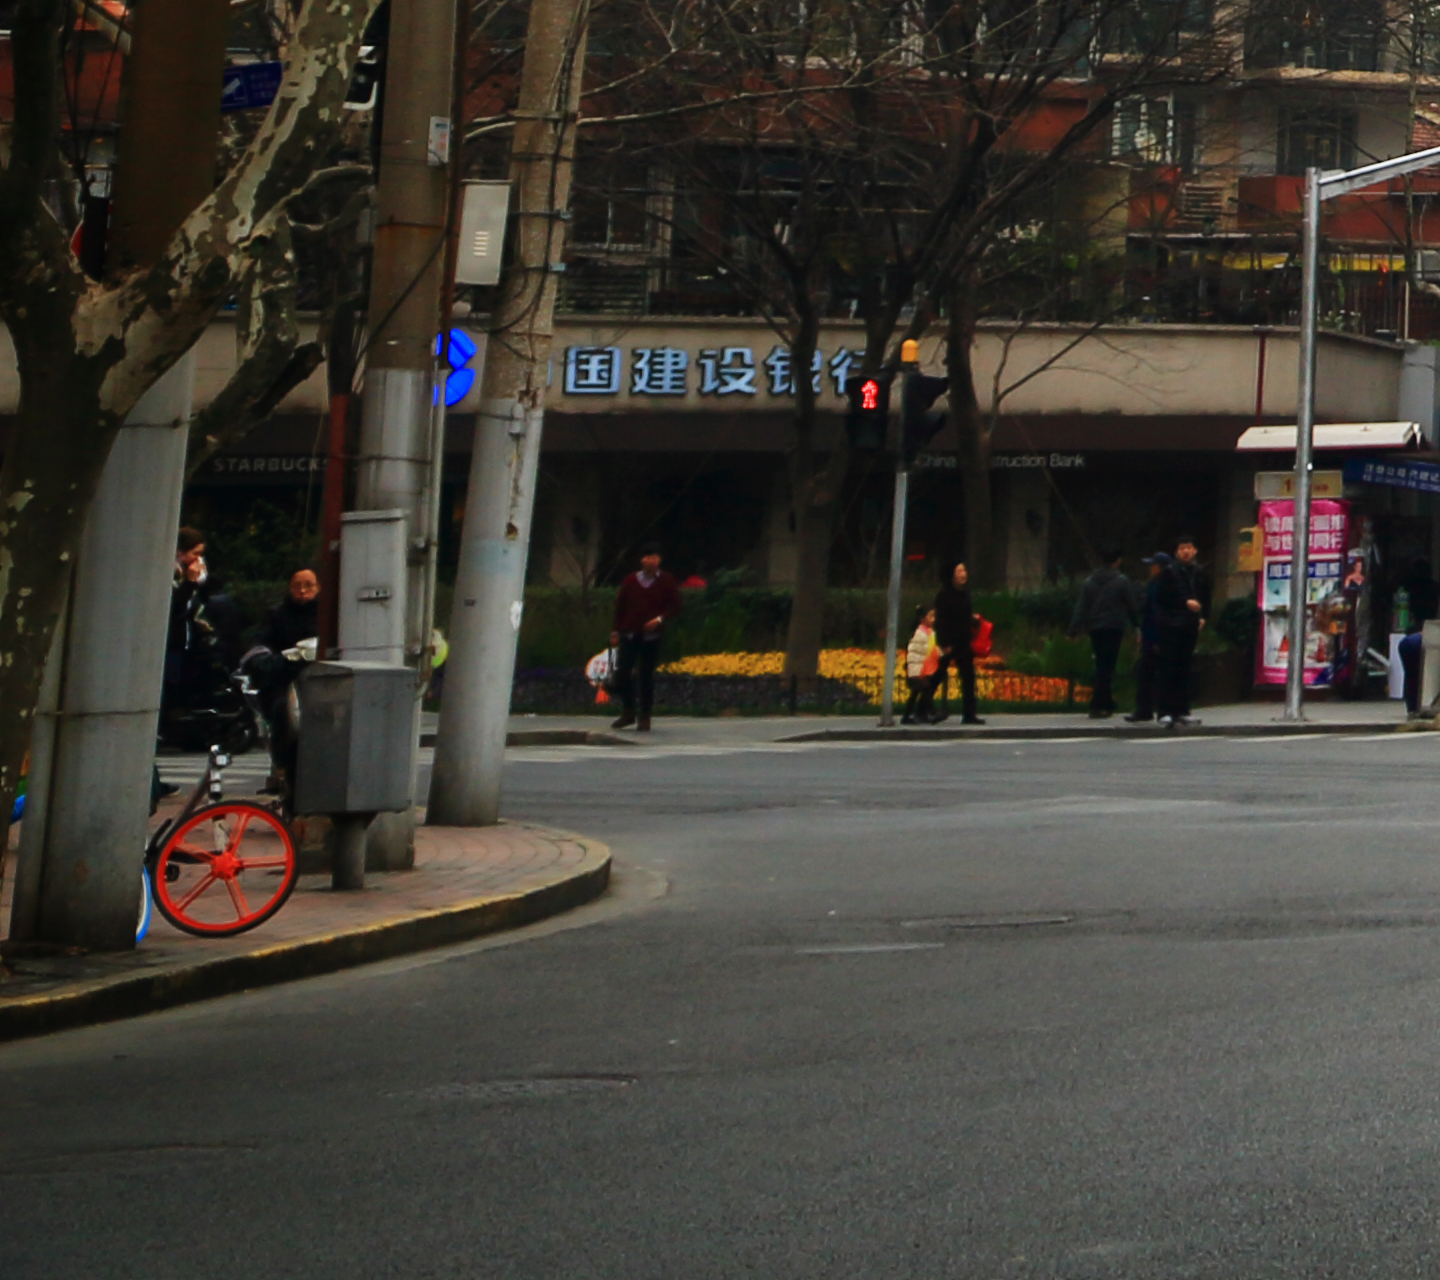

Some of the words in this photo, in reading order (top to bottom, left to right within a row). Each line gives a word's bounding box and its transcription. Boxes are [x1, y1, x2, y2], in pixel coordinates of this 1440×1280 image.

[546, 344, 870, 395] 国建设银行
[1050, 453, 1085, 468] Bank
